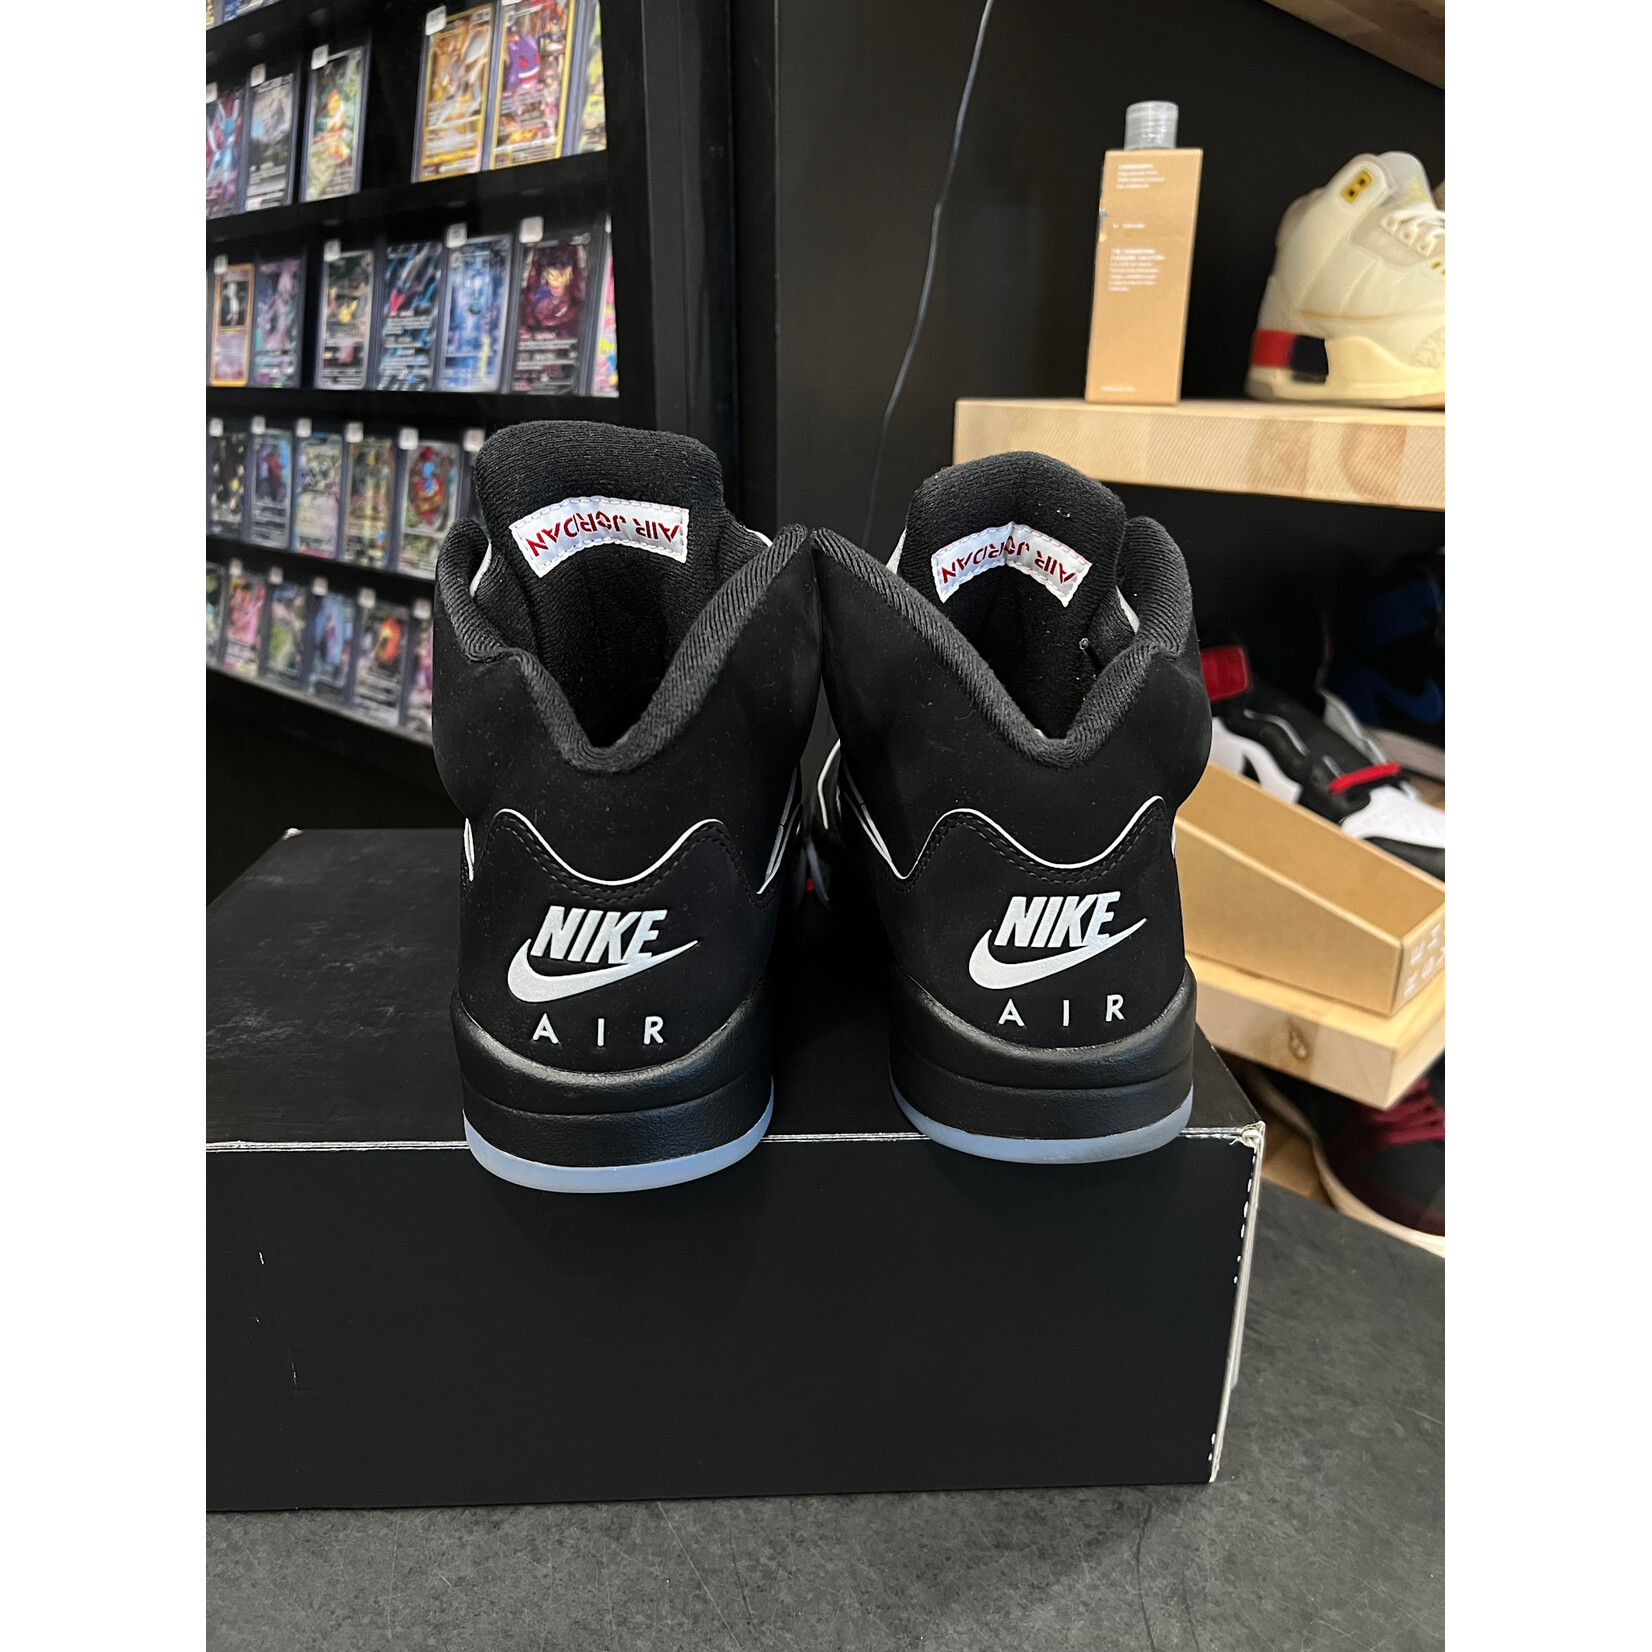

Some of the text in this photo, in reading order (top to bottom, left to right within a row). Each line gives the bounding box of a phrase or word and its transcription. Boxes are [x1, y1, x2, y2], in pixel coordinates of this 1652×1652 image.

[526, 511, 679, 557] AIR JORDAN
[941, 535, 1077, 583] AIR JORDAN
[530, 905, 668, 965] NIKE
[994, 891, 1121, 948] NIKE
[532, 1012, 664, 1046] AIR
[998, 993, 1125, 1027] AIR
